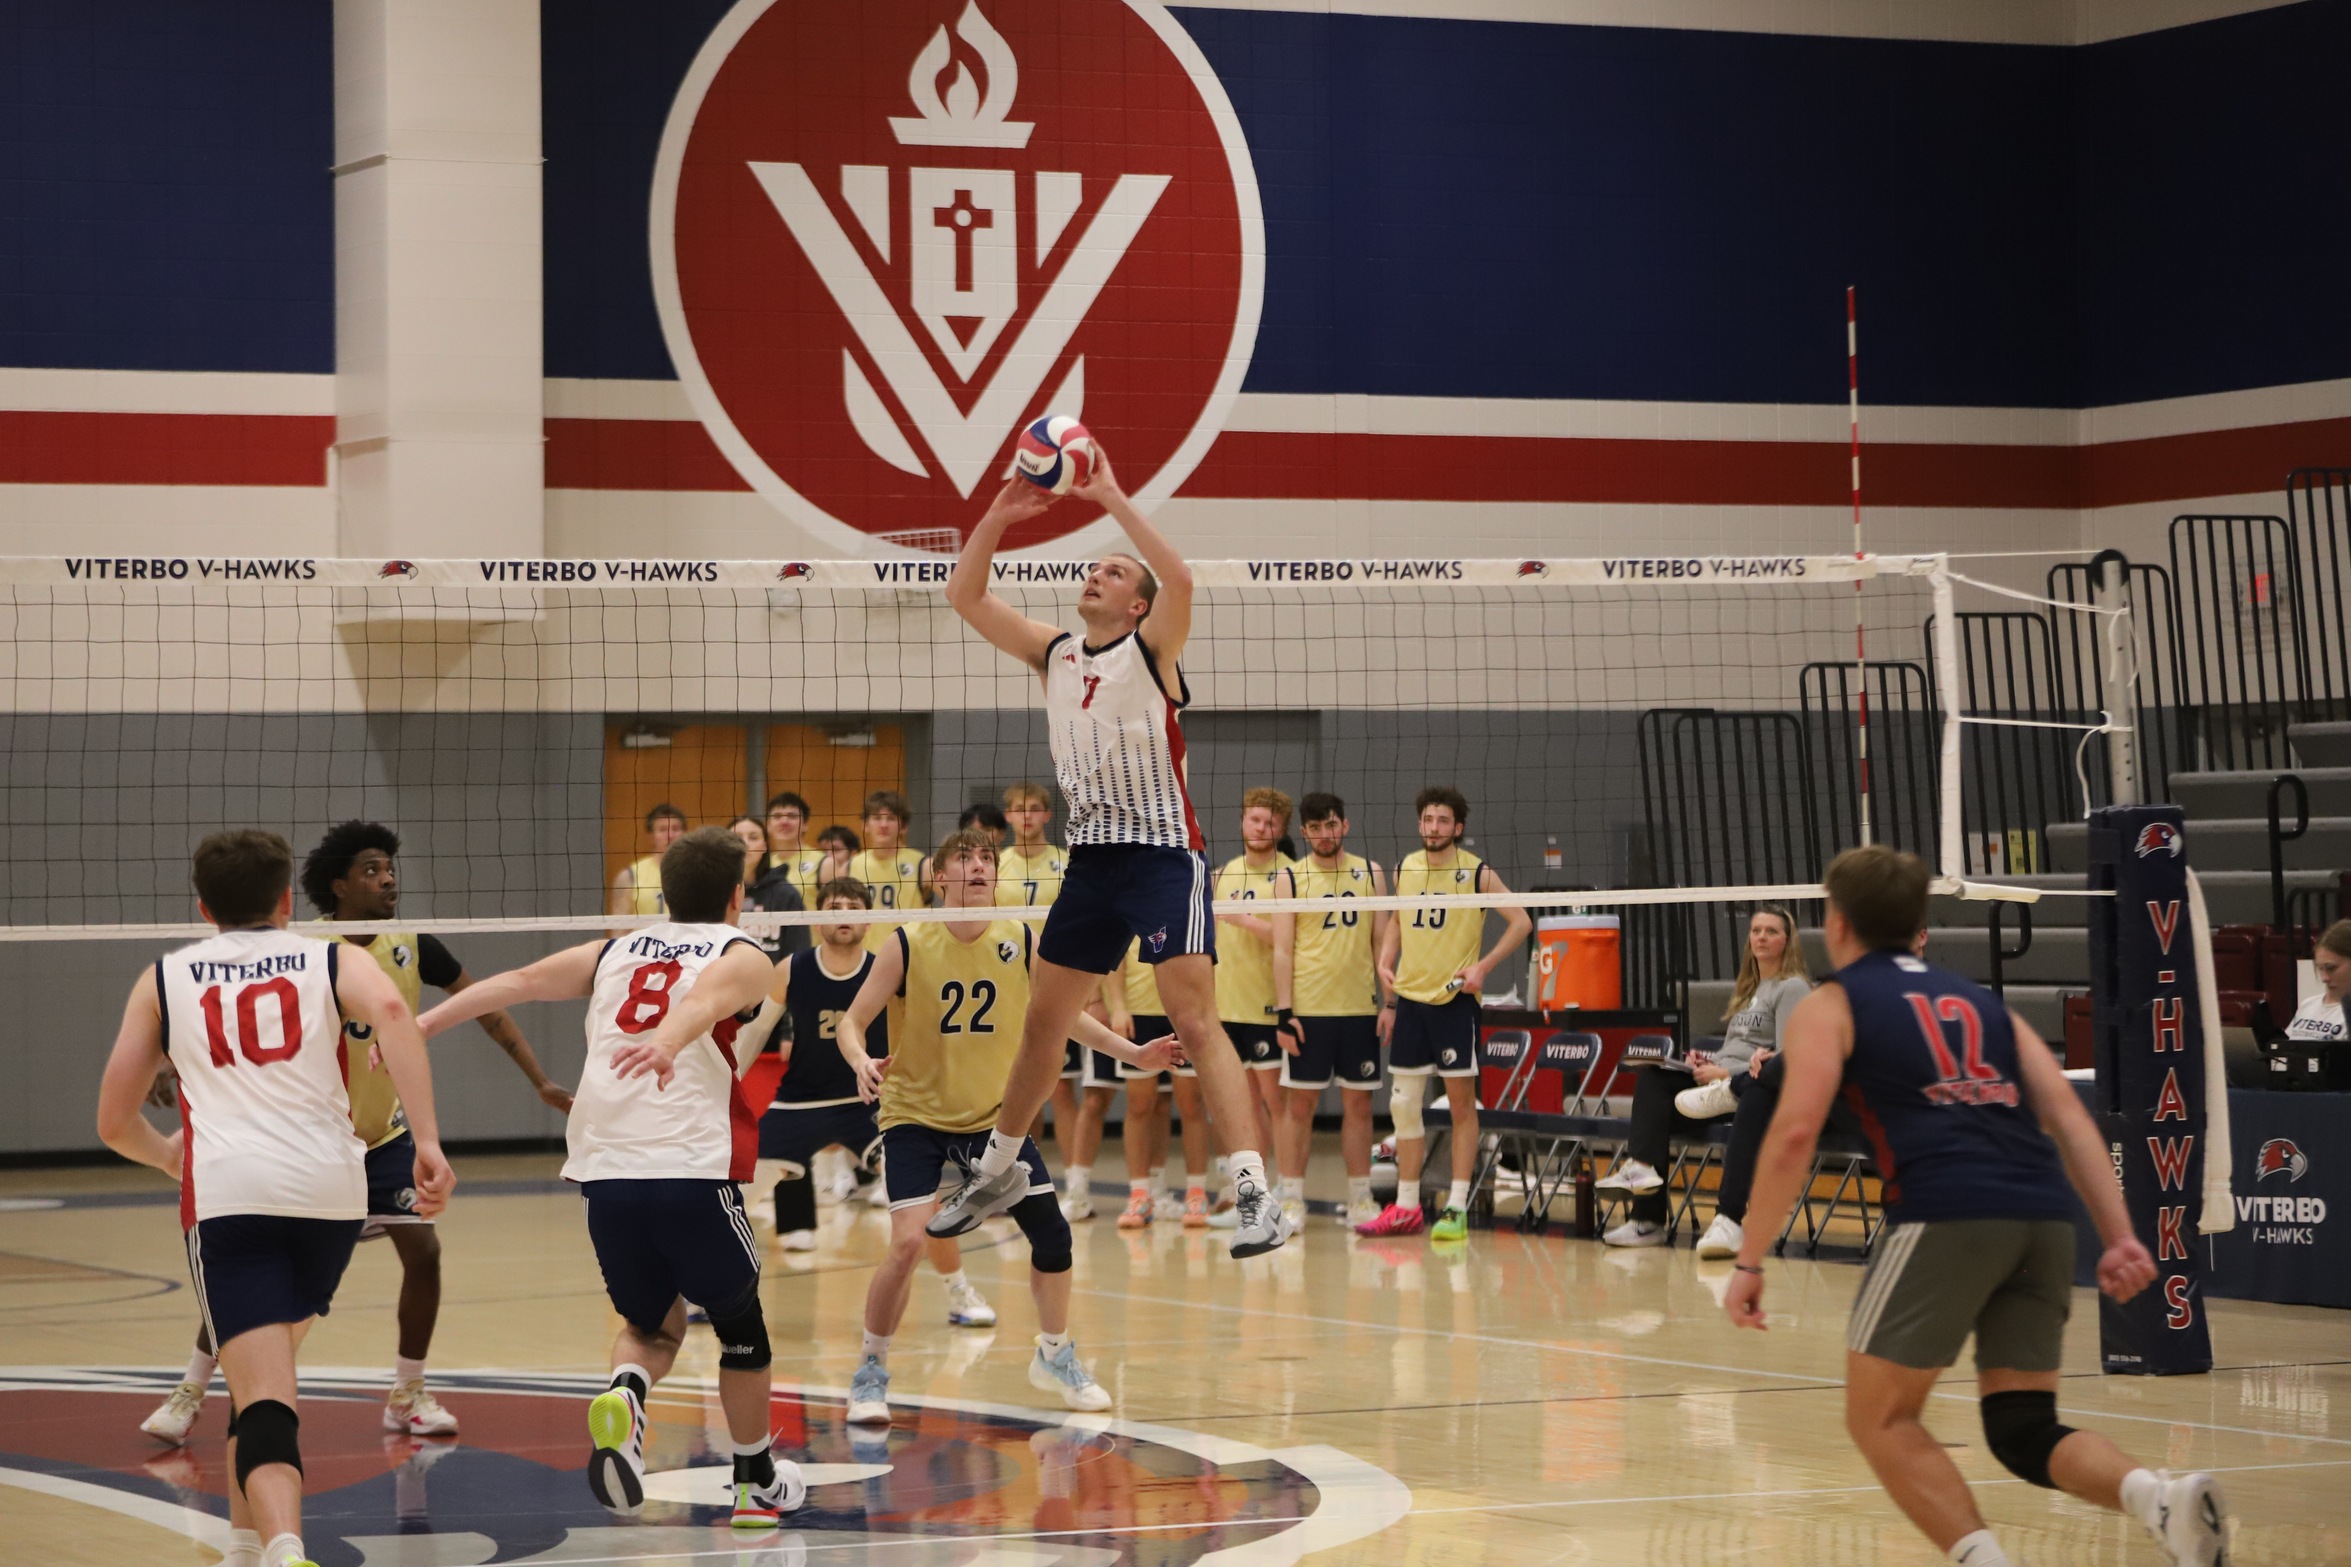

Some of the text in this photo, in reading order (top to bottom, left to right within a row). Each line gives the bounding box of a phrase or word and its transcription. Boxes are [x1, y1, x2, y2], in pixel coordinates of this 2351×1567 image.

[65, 559, 317, 580] VITERBO V-HAWKS
[480, 561, 718, 582] VITERBO V-HAWKS
[874, 563, 956, 582] VITER
[1248, 561, 1463, 581] VITERBO V-HAWKS
[1603, 558, 1807, 578] VITERBO V-HAWKS
[1082, 675, 1101, 710] 7
[189, 953, 306, 985] VITERBO
[615, 959, 684, 1034] 8
[940, 979, 997, 1035] 22
[200, 976, 303, 1068] 10
[1902, 992, 2002, 1081] 12
[1487, 1042, 1519, 1057] VITERBO
[1546, 1043, 1590, 1060] VITERBO
[2235, 1196, 2326, 1224] VITERBO
[2253, 1227, 2314, 1245] V-HAWKS
